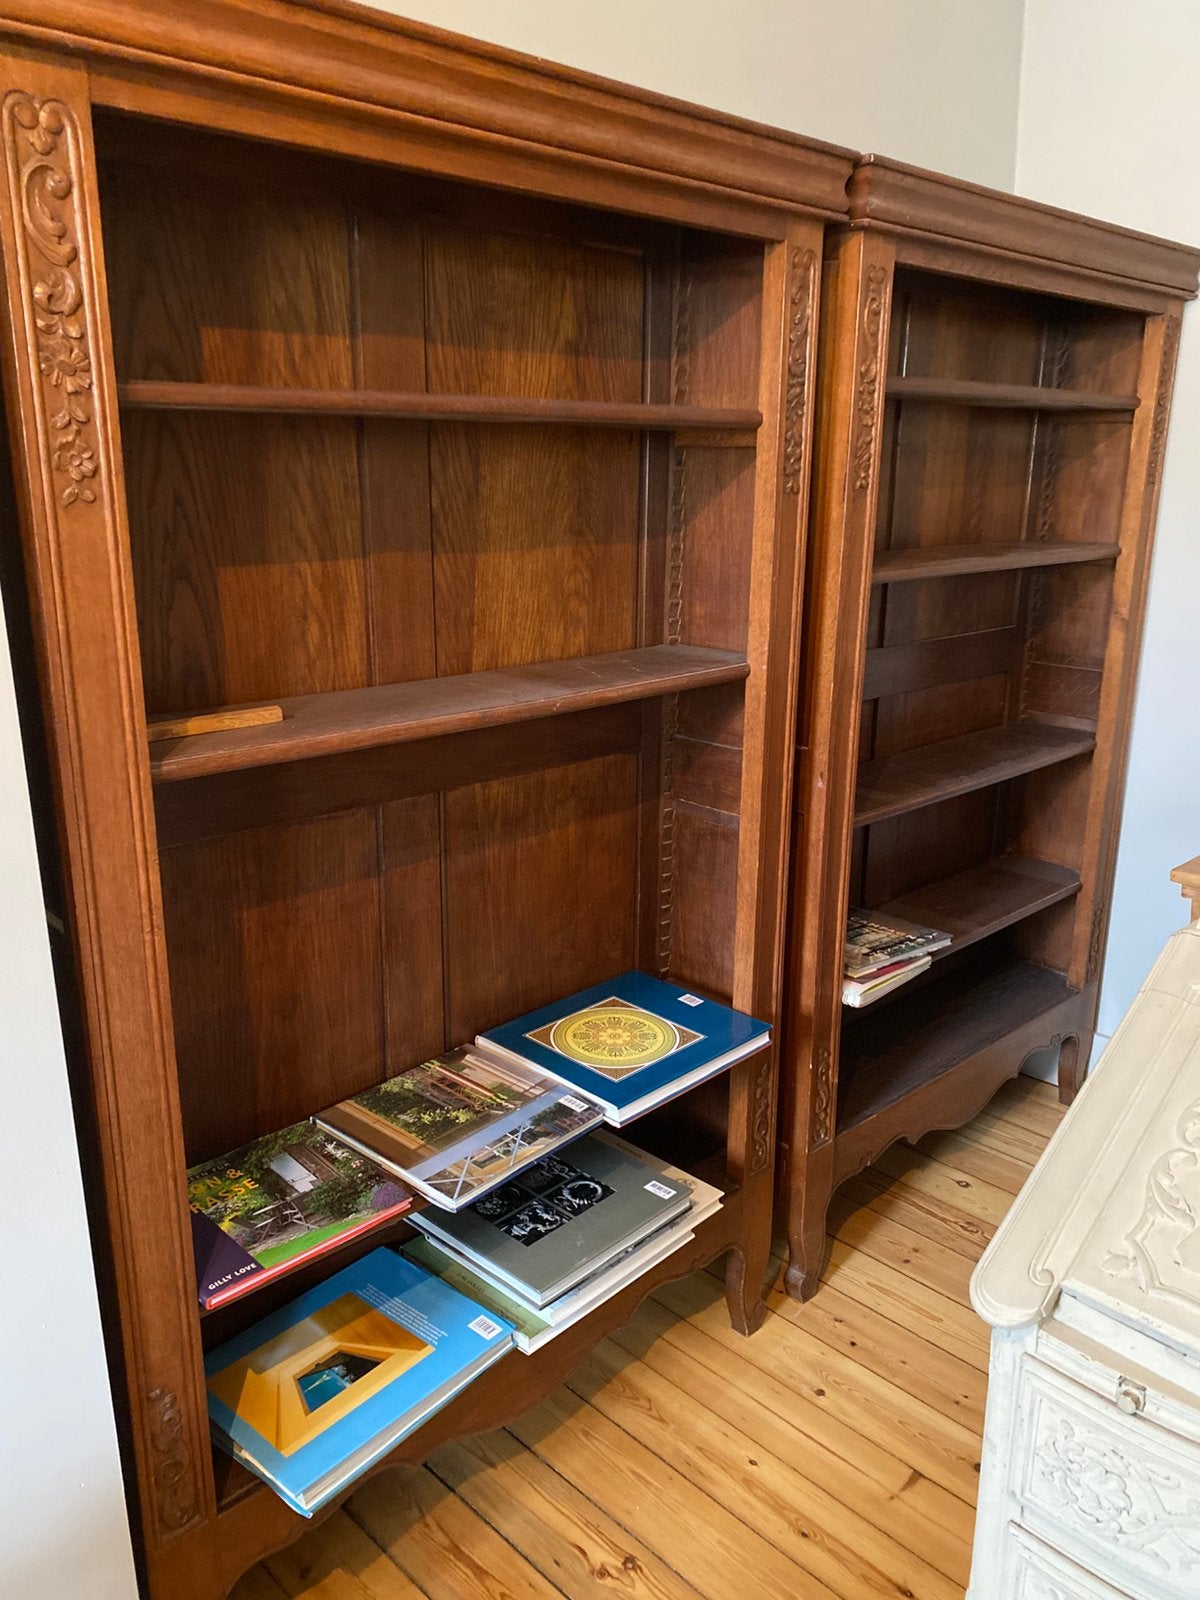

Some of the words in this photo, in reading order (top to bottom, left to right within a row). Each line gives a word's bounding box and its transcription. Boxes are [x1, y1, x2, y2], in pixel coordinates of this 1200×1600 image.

[226, 1168, 244, 1179] &
[189, 1178, 260, 1214] RASSE
[208, 1274, 233, 1290] GILLY
[234, 1262, 257, 1276] LOVE
